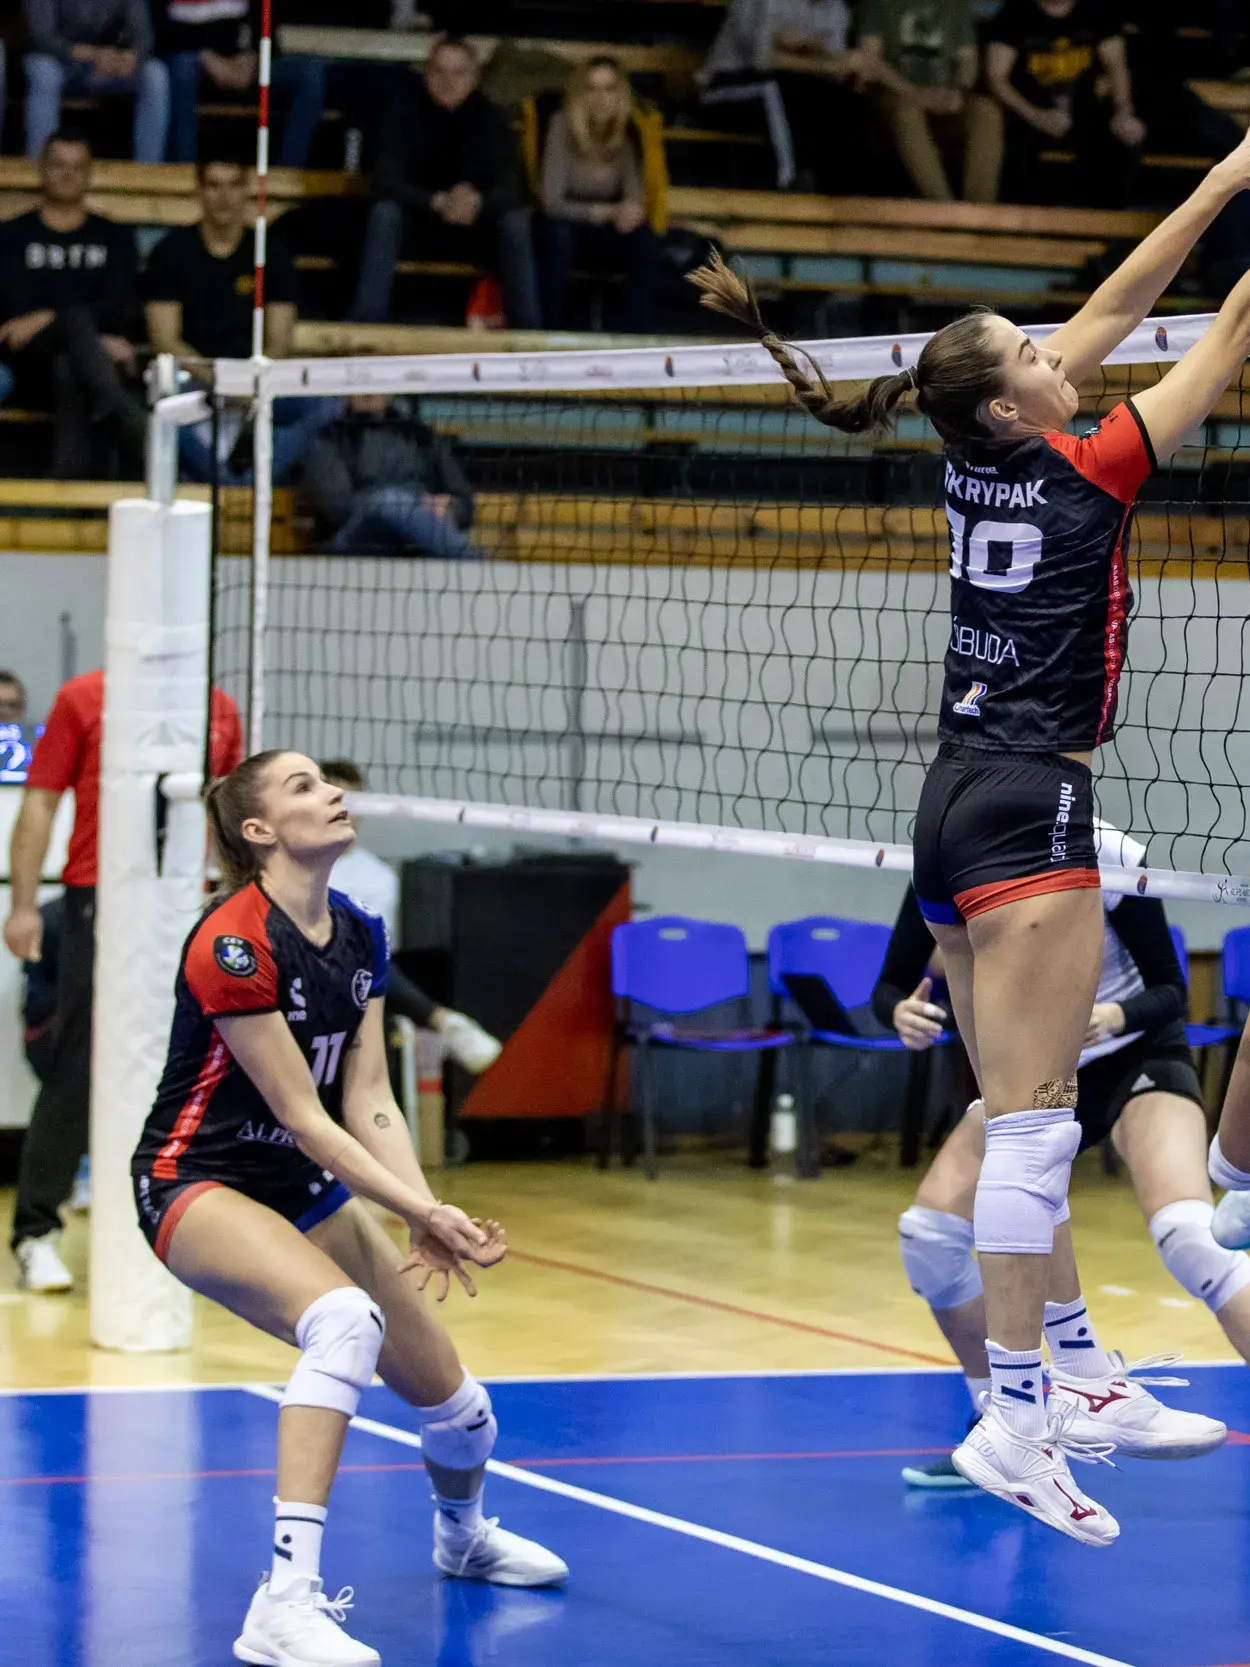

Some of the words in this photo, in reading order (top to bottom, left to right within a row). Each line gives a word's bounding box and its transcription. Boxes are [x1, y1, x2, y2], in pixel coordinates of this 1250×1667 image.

[946, 503, 1043, 594] 10
[949, 616, 1020, 667] ÓBUDA
[310, 1031, 347, 1087] 11
[236, 1120, 296, 1147] ALPR
